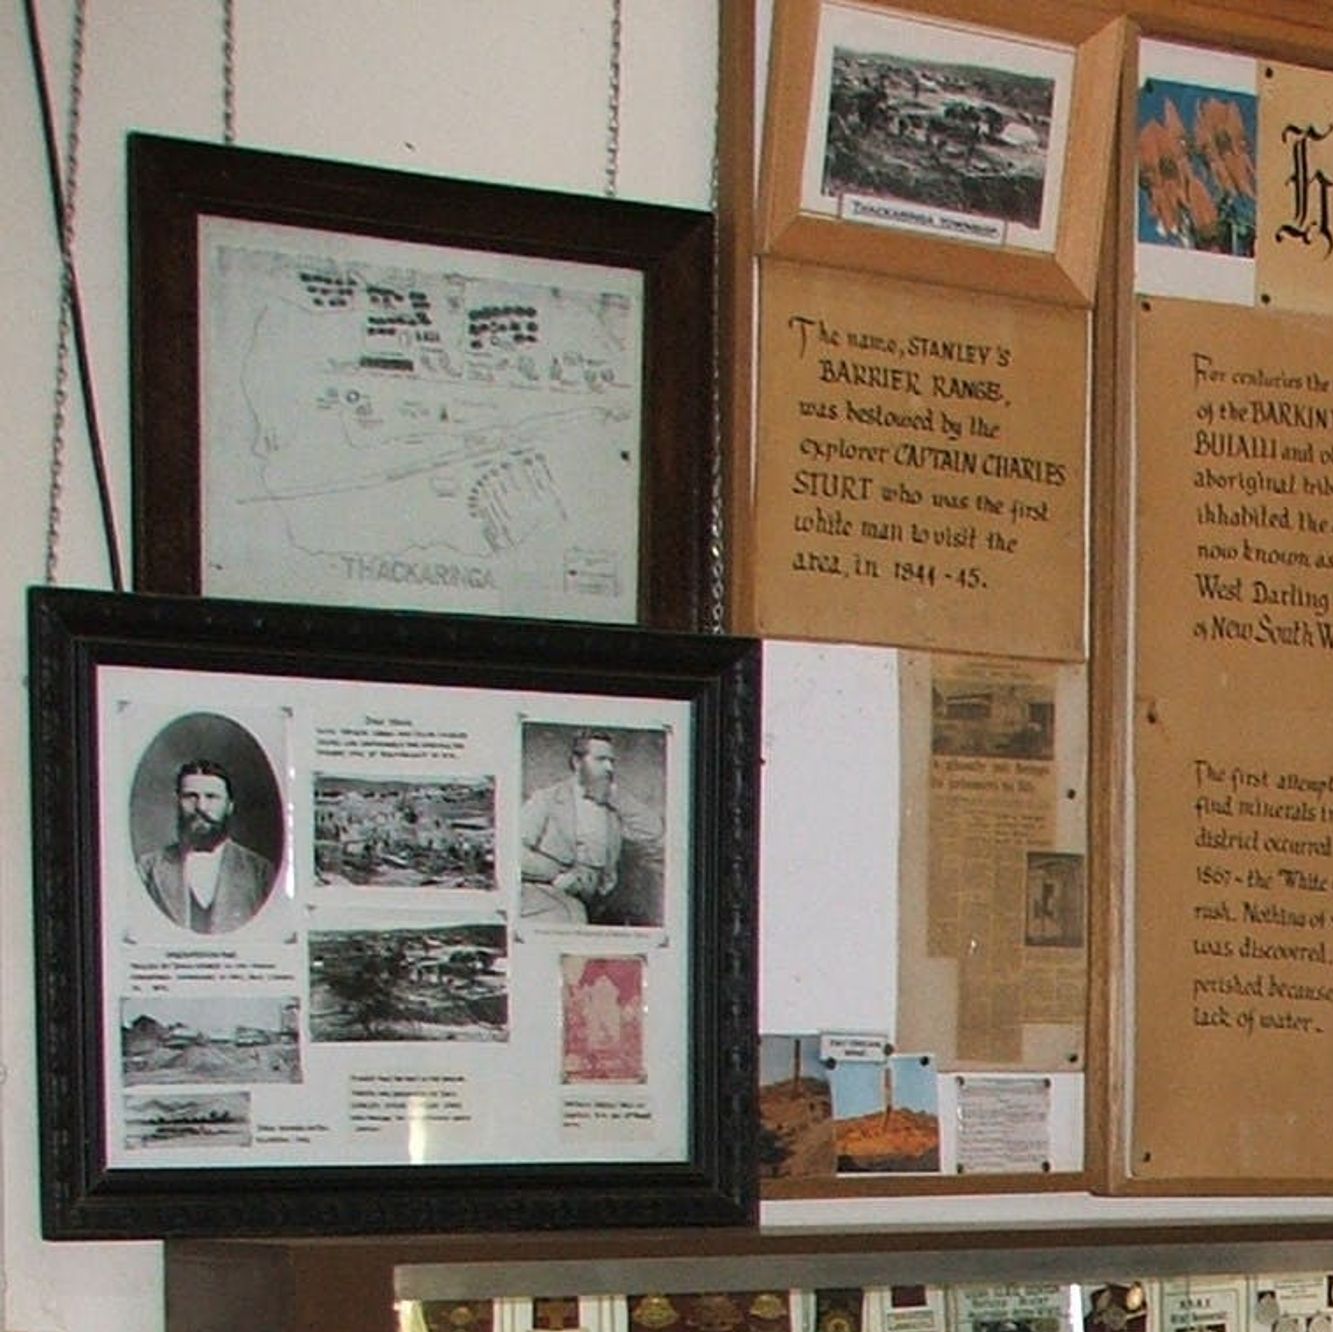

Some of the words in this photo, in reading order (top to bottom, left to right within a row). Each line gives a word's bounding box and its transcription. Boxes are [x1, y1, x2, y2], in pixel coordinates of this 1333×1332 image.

[819, 359, 921, 396] BARRIER
[1232, 369, 1303, 389] centuries
[1307, 371, 1329, 394] the
[847, 401, 933, 433] bestowed
[942, 413, 962, 441] by
[969, 418, 999, 439] the
[982, 453, 1067, 487] CHARLES
[1194, 469, 1297, 495] aboriginal
[793, 470, 872, 500] STURT
[881, 483, 921, 506] who
[977, 493, 1003, 515] the
[1011, 502, 1049, 527] first
[861, 520, 903, 541] man
[912, 523, 932, 545] to
[934, 524, 976, 548] visit
[987, 530, 1018, 553] the
[1195, 573, 1242, 601] West
[1252, 581, 1330, 617] Darling
[1211, 616, 1252, 640] New
[1255, 614, 1314, 649] South
[1194, 1007, 1231, 1028] lack
